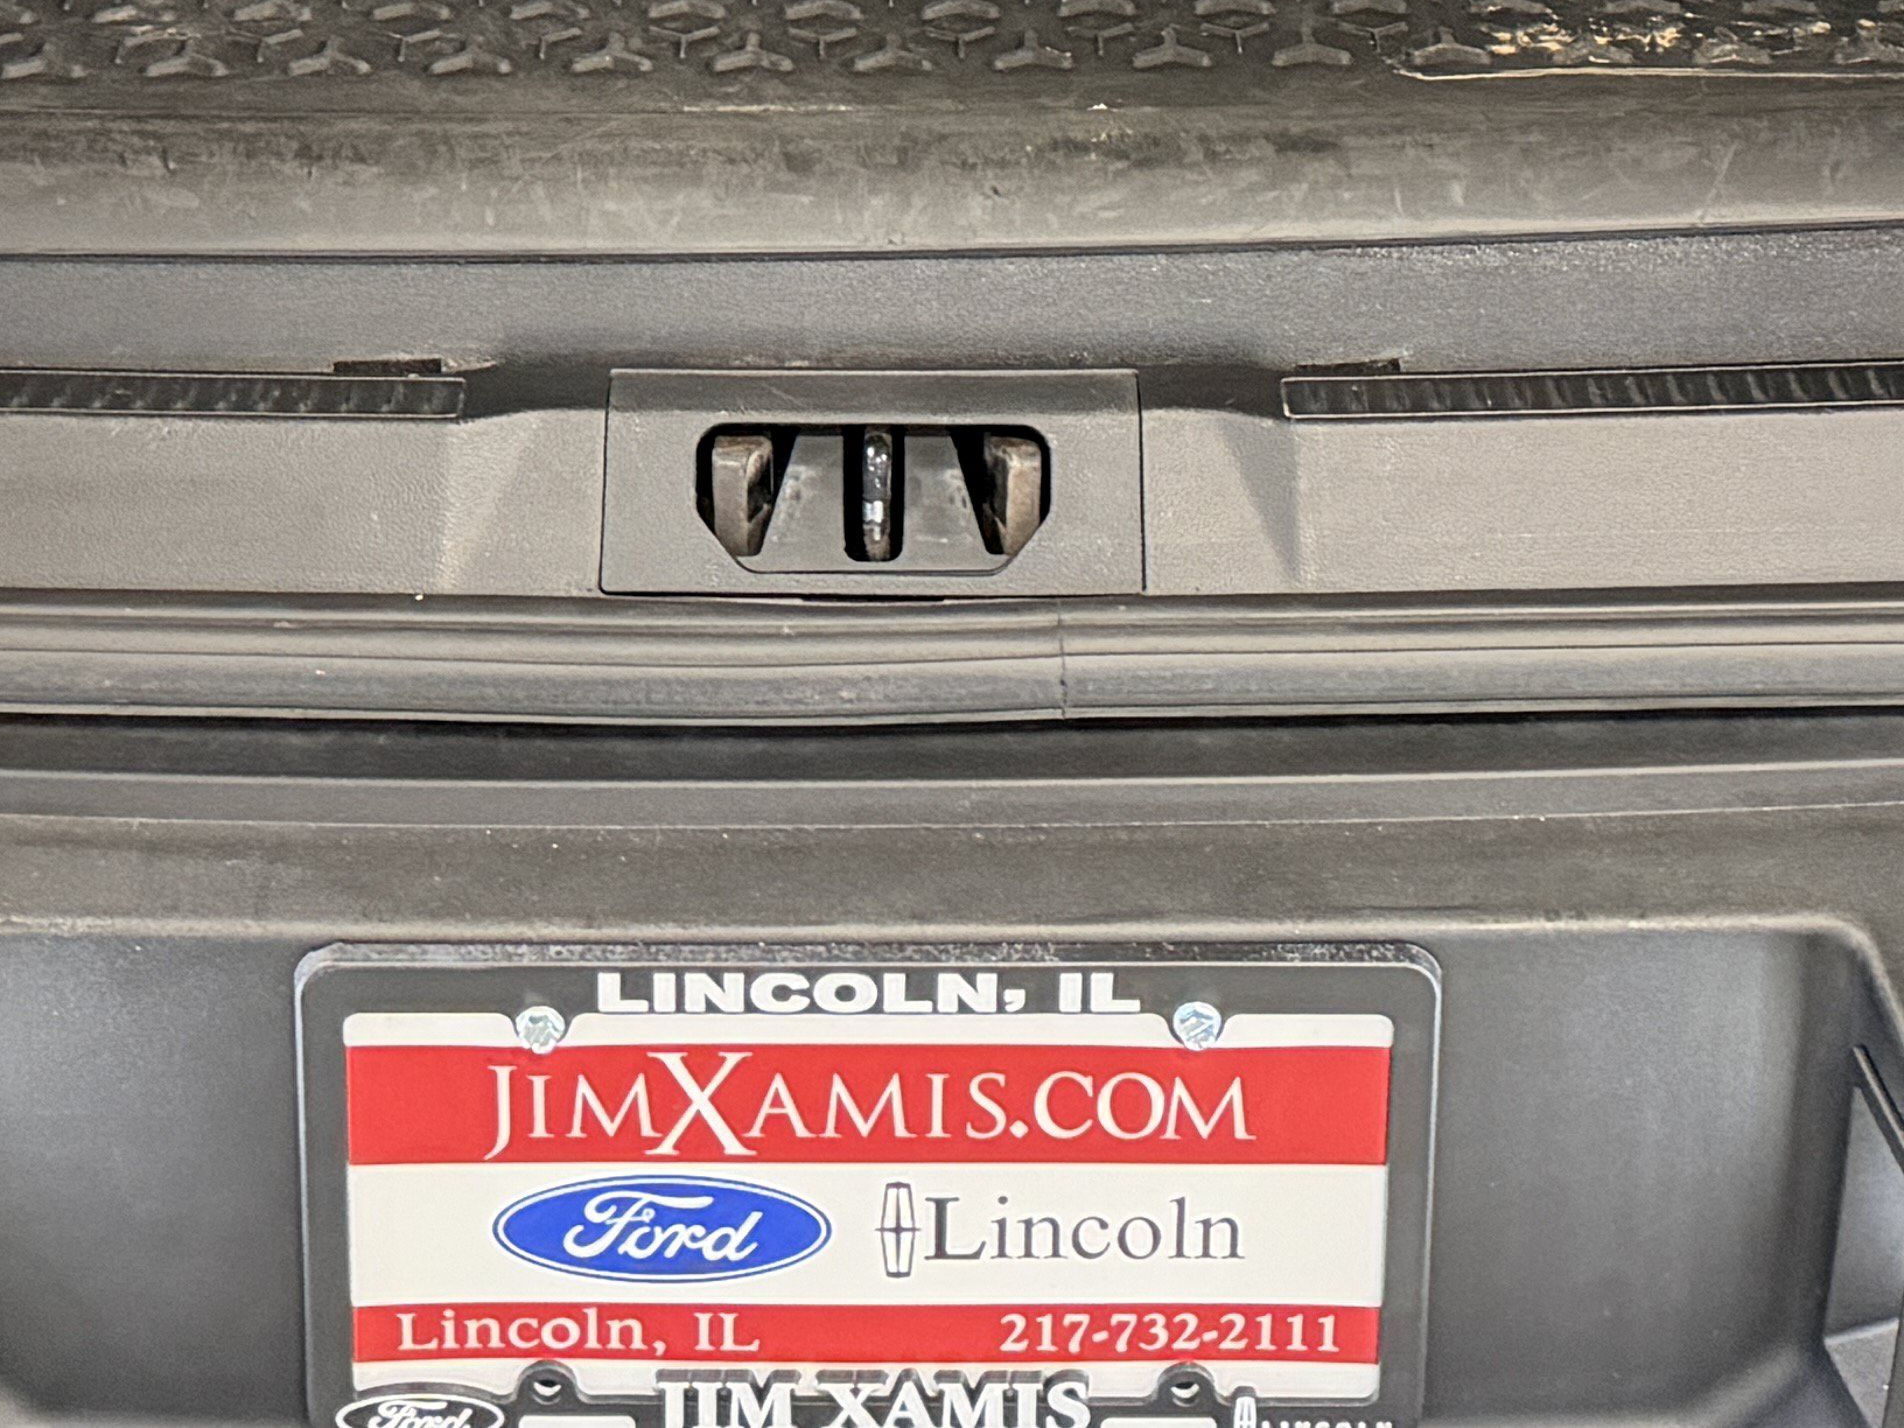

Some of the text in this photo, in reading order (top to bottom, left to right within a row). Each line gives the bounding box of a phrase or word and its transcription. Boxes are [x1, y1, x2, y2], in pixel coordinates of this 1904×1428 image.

[597, 972, 1141, 1013] LINCOLN, IL
[562, 1190, 764, 1262] Ford
[924, 1195, 1246, 1261] Lincoln
[396, 1308, 761, 1356] Lincoln, IL
[999, 1313, 1341, 1353] 217-732-2111
[658, 1381, 1091, 1428] JIM XAMIS
